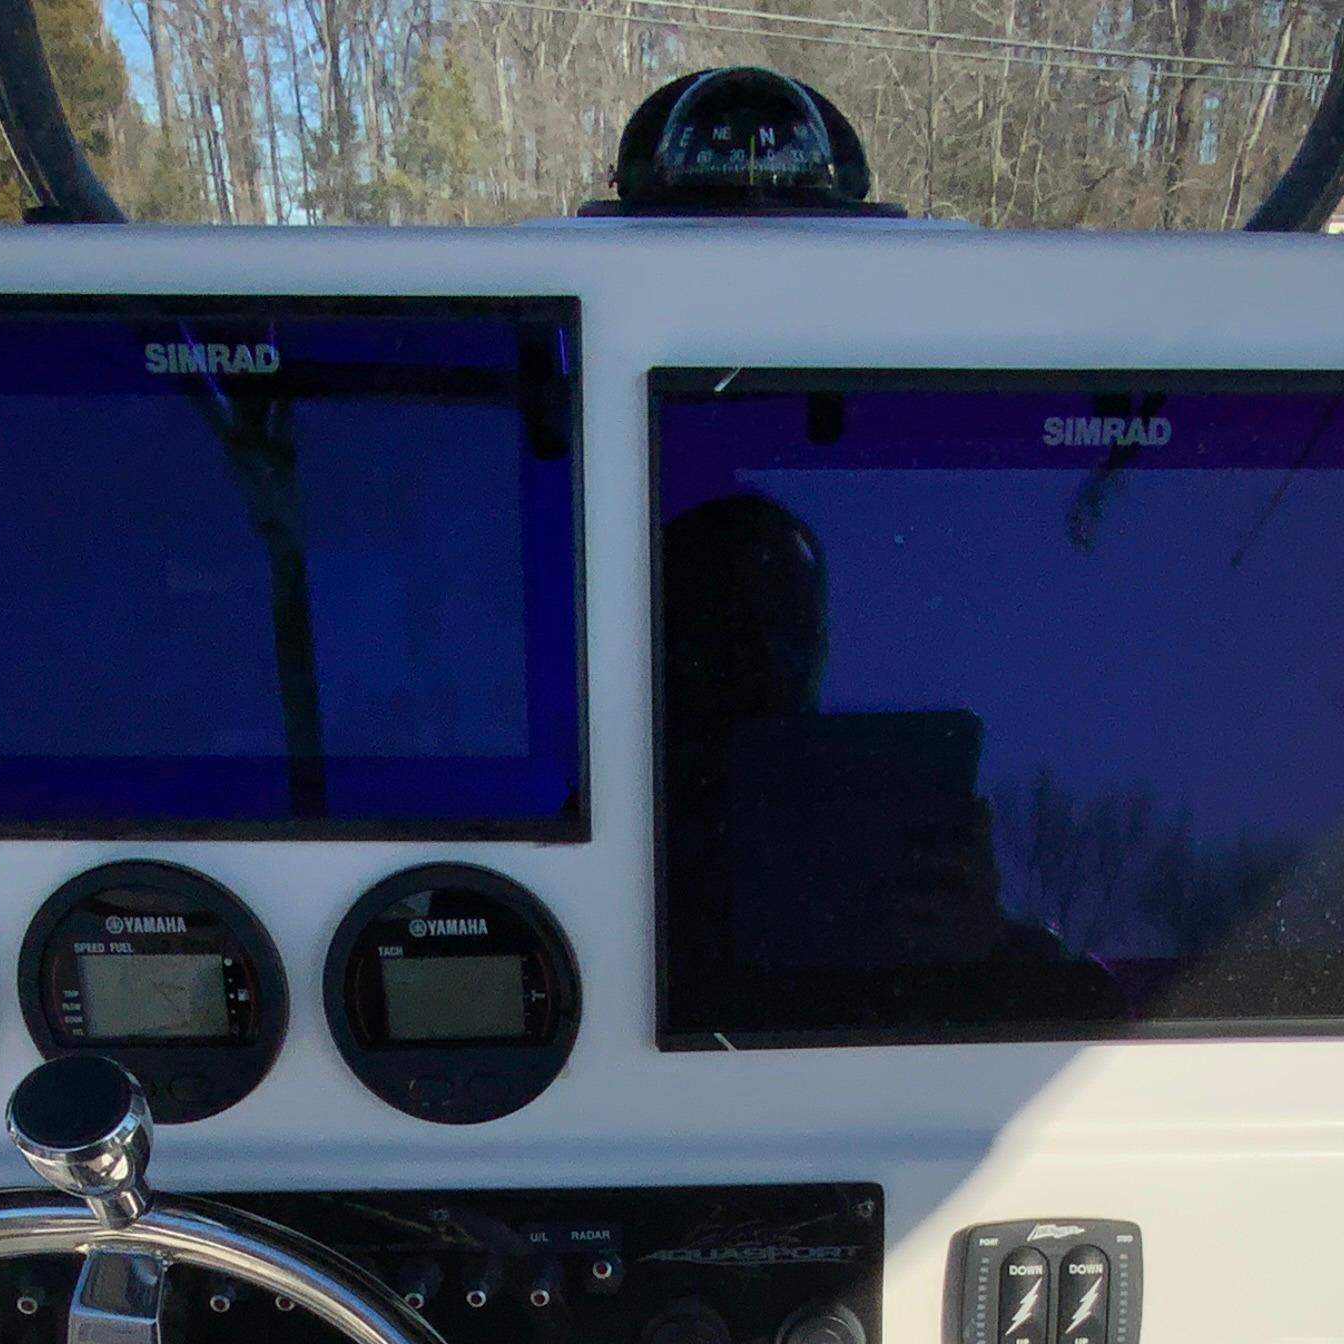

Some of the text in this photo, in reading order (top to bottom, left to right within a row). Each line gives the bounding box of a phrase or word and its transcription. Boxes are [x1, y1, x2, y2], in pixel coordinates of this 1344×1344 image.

[758, 126, 776, 147] N
[144, 342, 280, 375] SIMRAD
[1042, 416, 1172, 447] SIMRAD
[122, 915, 187, 933] YAMAHA
[427, 918, 488, 936] YAMAHA
[74, 942, 134, 953] SPEED FUEL
[377, 945, 404, 957] TACH
[570, 1230, 609, 1241] RADAR
[979, 1237, 998, 1247] PORT
[1009, 1264, 1043, 1275] DOWN
[1068, 1263, 1103, 1274] DOWN
